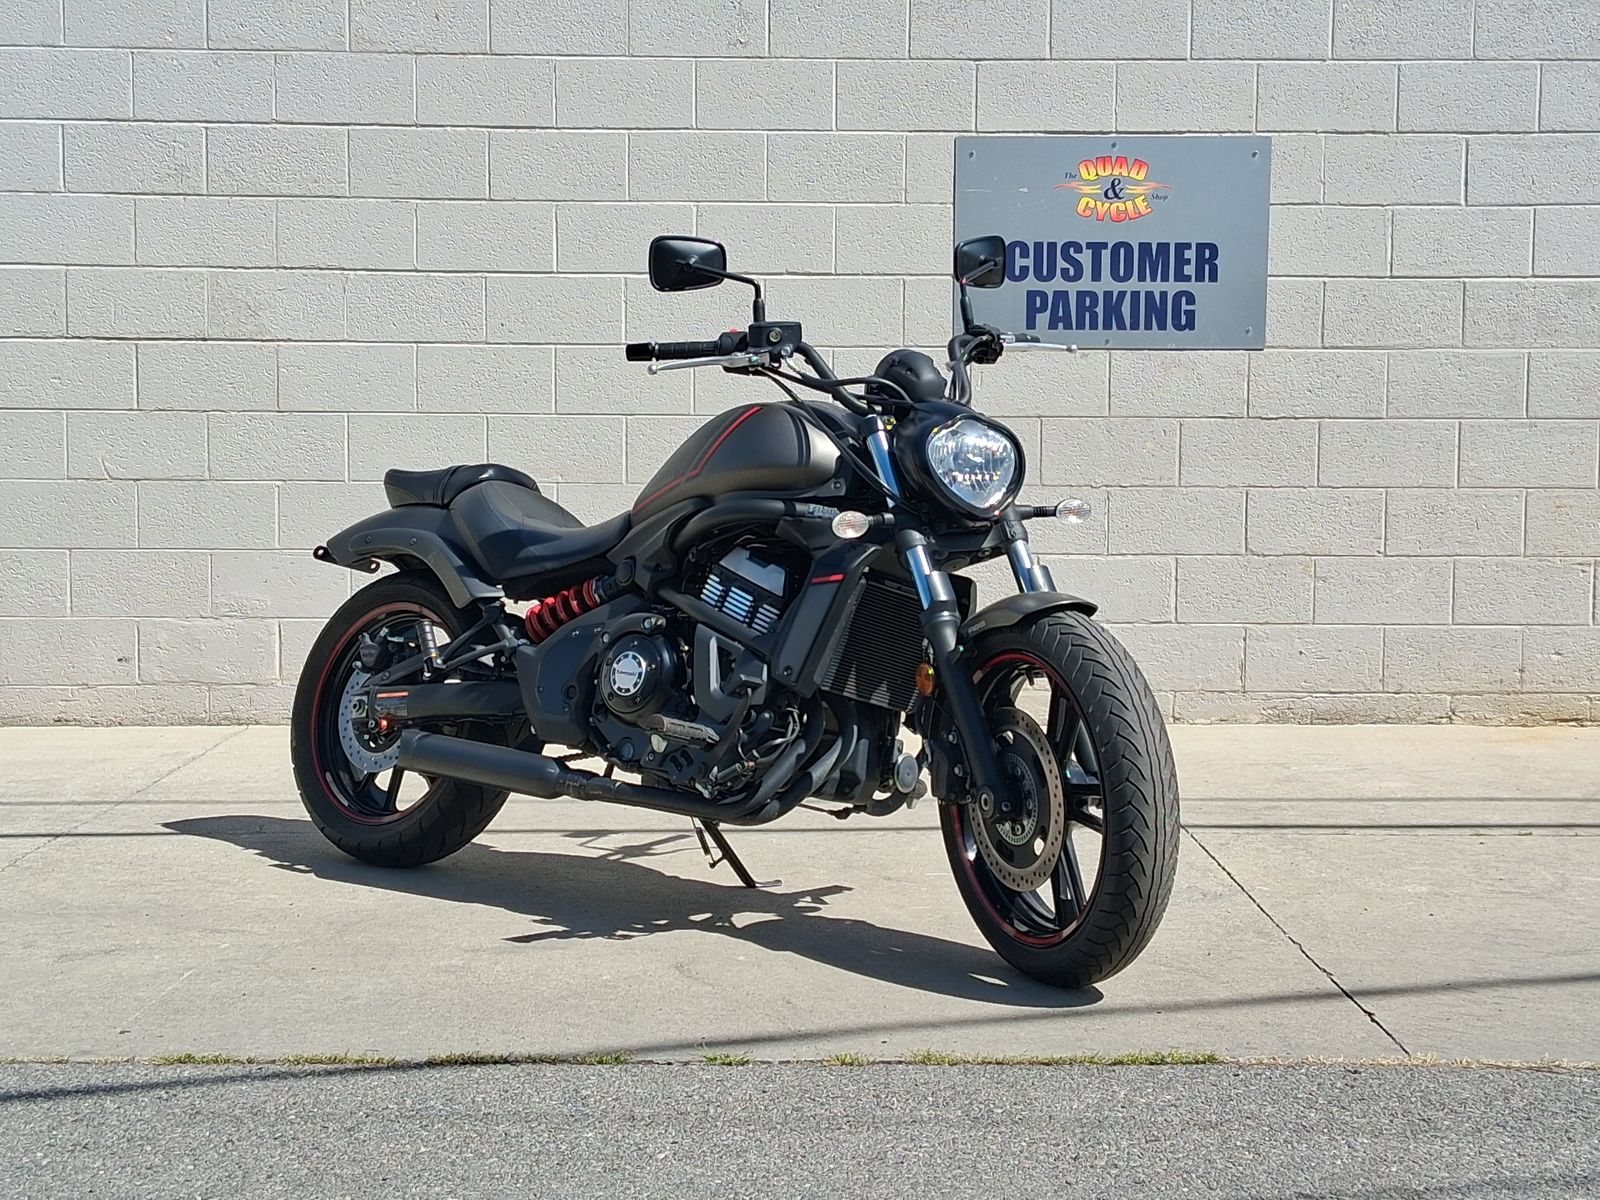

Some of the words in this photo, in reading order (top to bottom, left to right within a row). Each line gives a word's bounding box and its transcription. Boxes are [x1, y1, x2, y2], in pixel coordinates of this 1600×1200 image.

[1078, 156, 1150, 181] QUAD
[1104, 178, 1125, 200] &
[1150, 193, 1169, 202] Shop
[1076, 195, 1153, 223] CYCLE
[1005, 241, 1219, 283] CUSTOMER
[1026, 290, 1196, 332] PARKING
